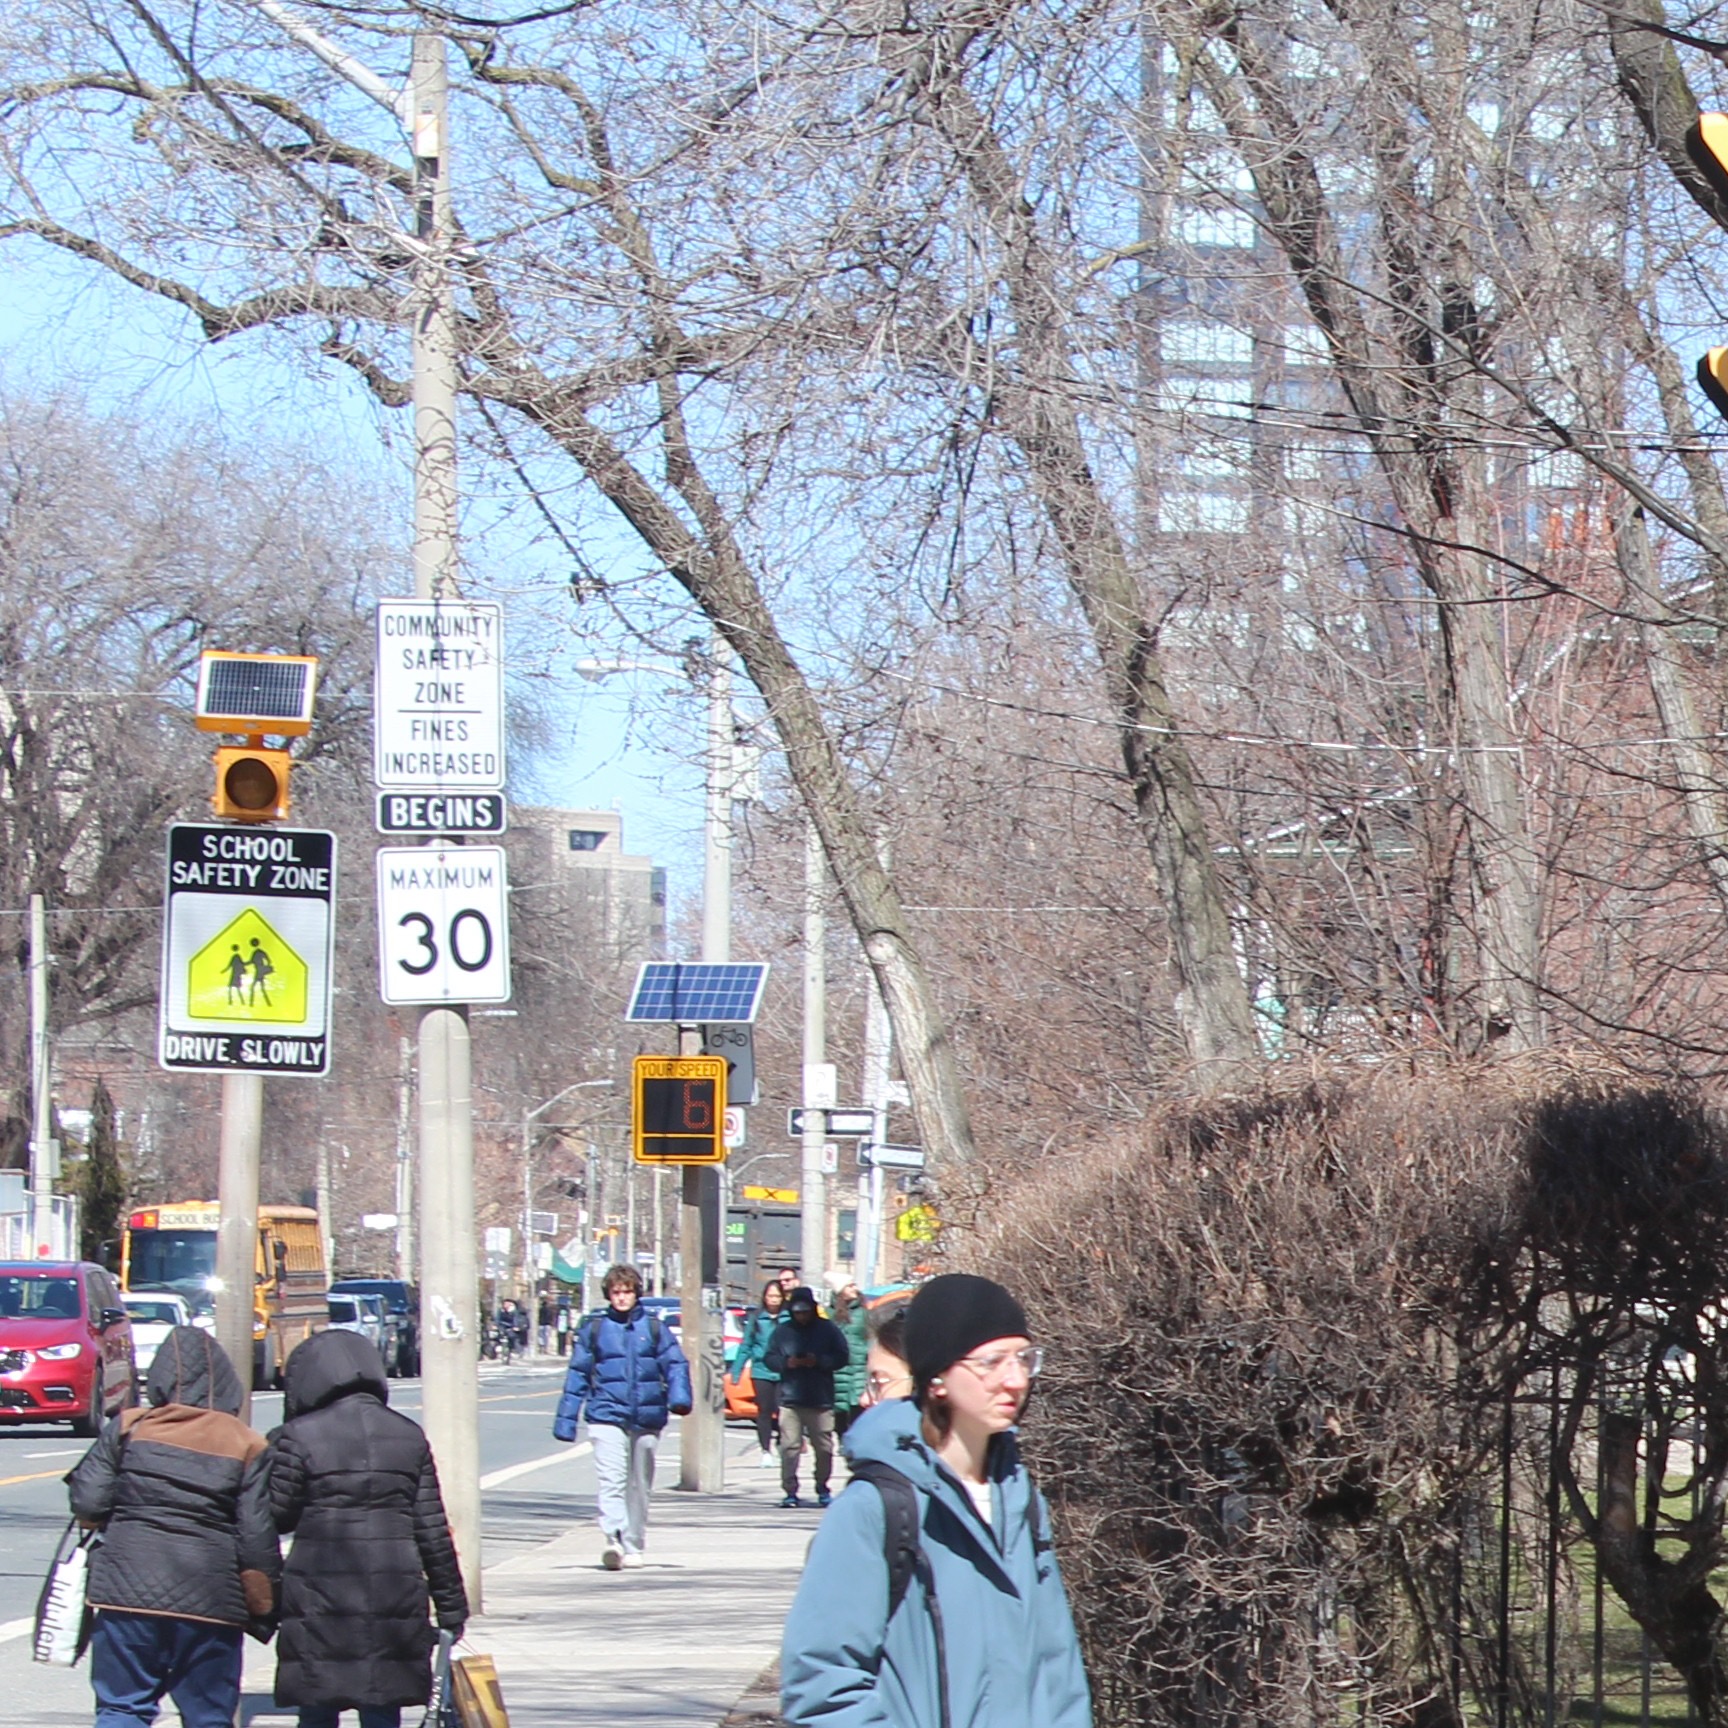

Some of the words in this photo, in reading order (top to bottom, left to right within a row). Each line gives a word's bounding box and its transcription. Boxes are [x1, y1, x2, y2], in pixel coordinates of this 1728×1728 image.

[385, 615, 492, 637] COMMUNITY
[402, 648, 476, 670] SAFETY
[414, 682, 465, 703] ZONE
[411, 719, 469, 741] FINES
[385, 752, 495, 774] INCREASED
[390, 797, 494, 827] BEGINS
[202, 834, 301, 862] SCHOOL
[172, 861, 262, 887] SAFETY
[270, 866, 329, 891] ZONE
[390, 867, 493, 889] MAXIMUM
[398, 908, 493, 975] 30
[241, 1038, 324, 1066] SLOWLY
[640, 1063, 675, 1077] YOUR
[679, 1063, 719, 1077] SPEED
[683, 1080, 711, 1129] 6
[160, 1213, 199, 1225] SCHOOL
